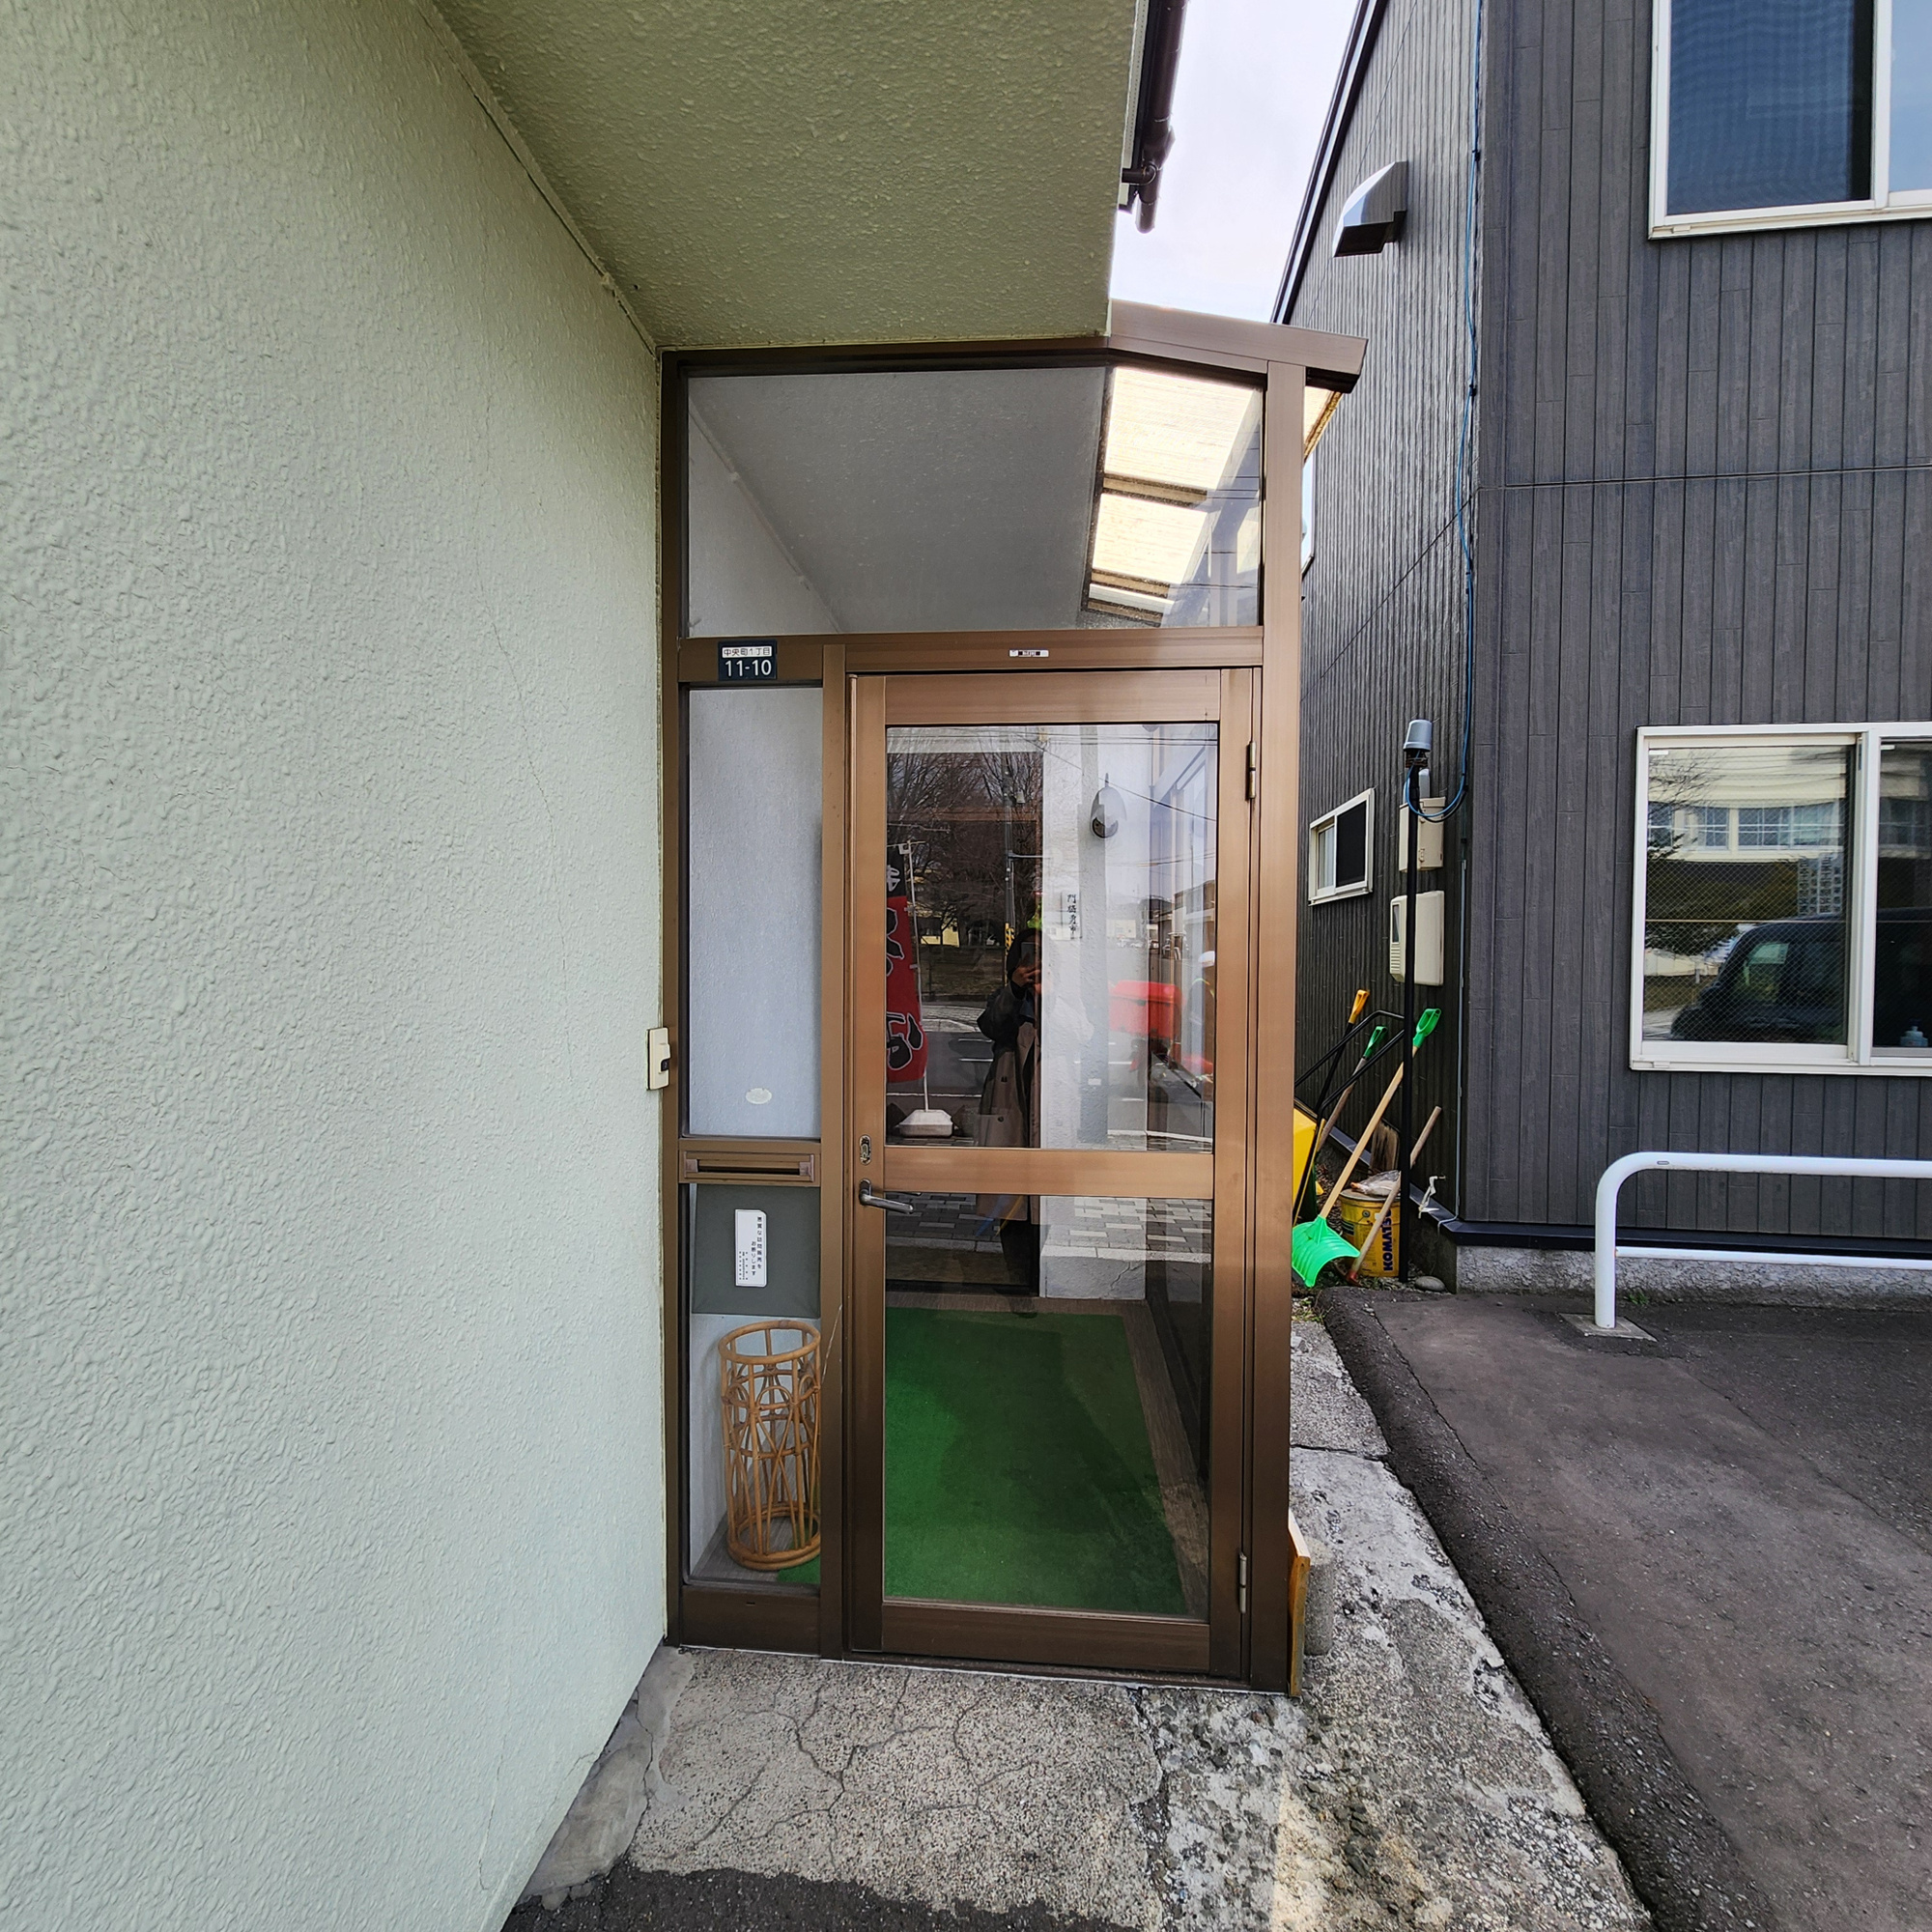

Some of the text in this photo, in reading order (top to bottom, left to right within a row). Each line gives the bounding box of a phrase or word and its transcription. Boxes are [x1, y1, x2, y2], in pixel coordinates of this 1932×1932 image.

[723, 647, 771, 657] 中央町1丁目
[724, 659, 772, 677] 11-10
